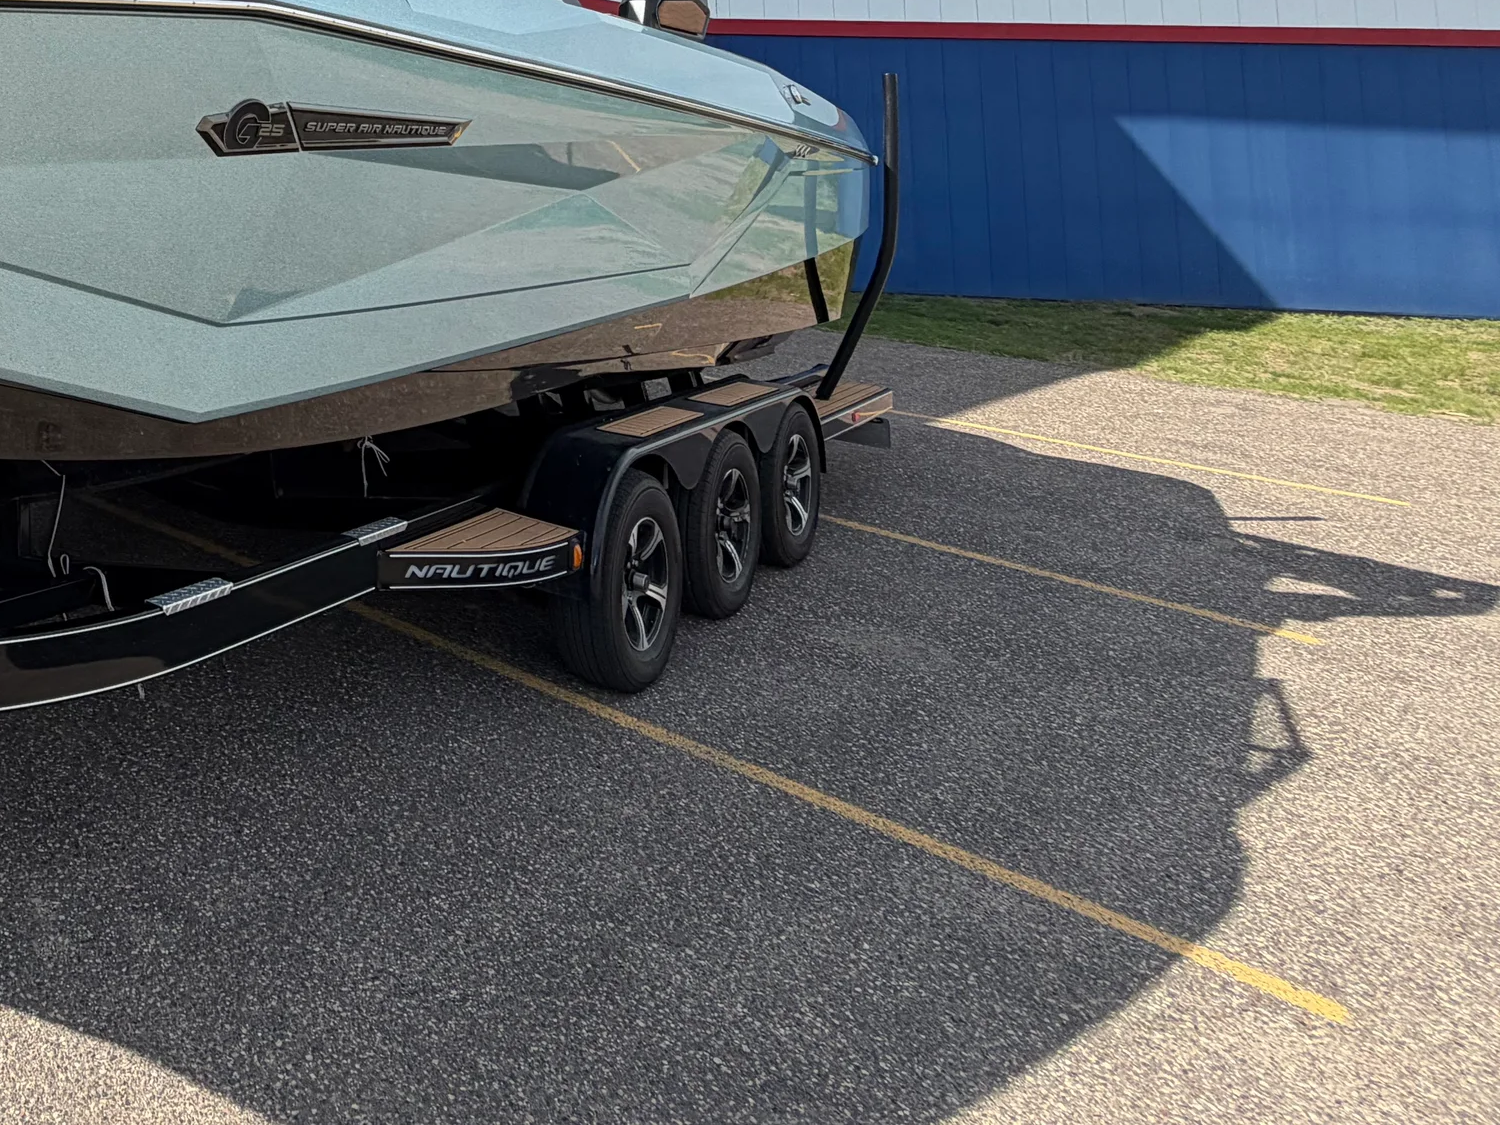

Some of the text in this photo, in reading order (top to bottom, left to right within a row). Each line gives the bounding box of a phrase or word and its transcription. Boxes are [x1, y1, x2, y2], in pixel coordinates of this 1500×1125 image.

[304, 121, 356, 133] SUPER
[358, 123, 382, 134] AIR
[383, 124, 447, 135] NAUTIQUE
[404, 555, 556, 579] NAUTIQUE
